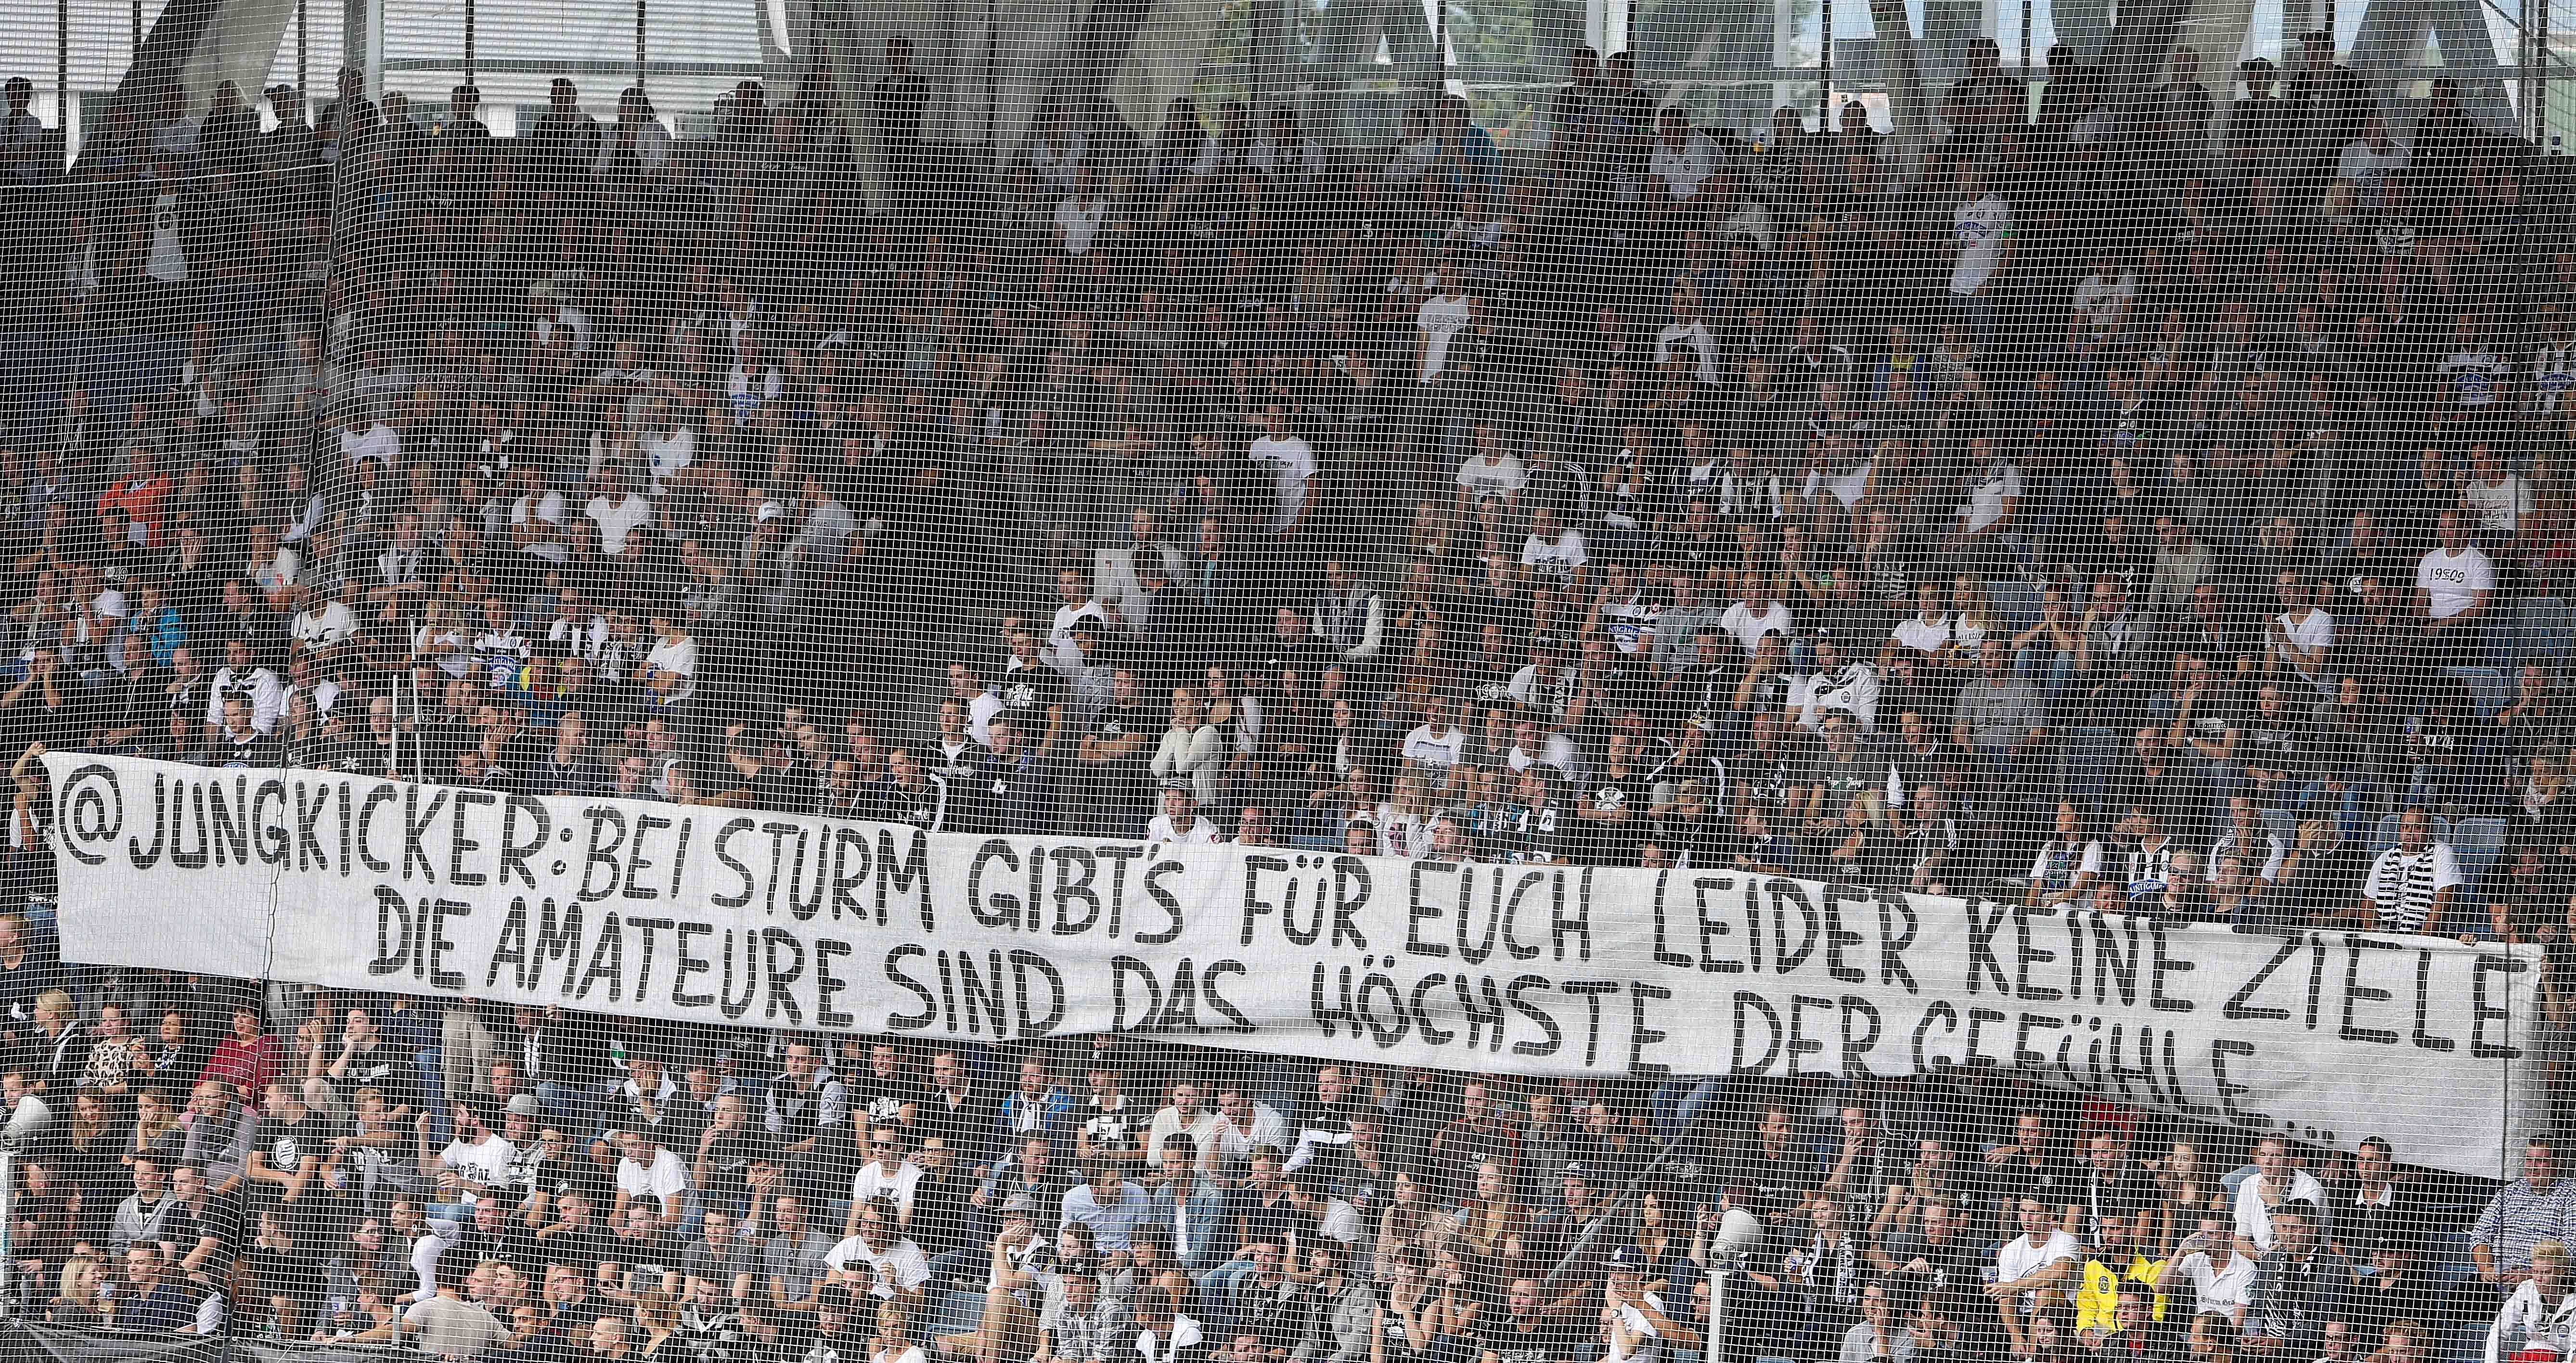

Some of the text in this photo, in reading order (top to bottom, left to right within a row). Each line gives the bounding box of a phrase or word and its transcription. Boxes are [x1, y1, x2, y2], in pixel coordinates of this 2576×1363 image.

[367, 885, 472, 989] DIE
[487, 895, 855, 1028] AMATEURE
[885, 943, 1066, 1039] SIND
[1111, 955, 1258, 1034] DAS
[1312, 954, 1672, 1078] HÖCHSTE
[1731, 990, 1882, 1078] DER
[577, 804, 691, 903] BEI
[711, 818, 935, 933] STURM
[969, 839, 1184, 944] GIBT'S
[1241, 855, 1371, 951] FÜR
[1406, 862, 1592, 964] EUCH
[1654, 869, 1919, 995] LEIDER
[1967, 897, 2195, 1012] KEINE
[2223, 924, 2528, 1059] ZIELE
